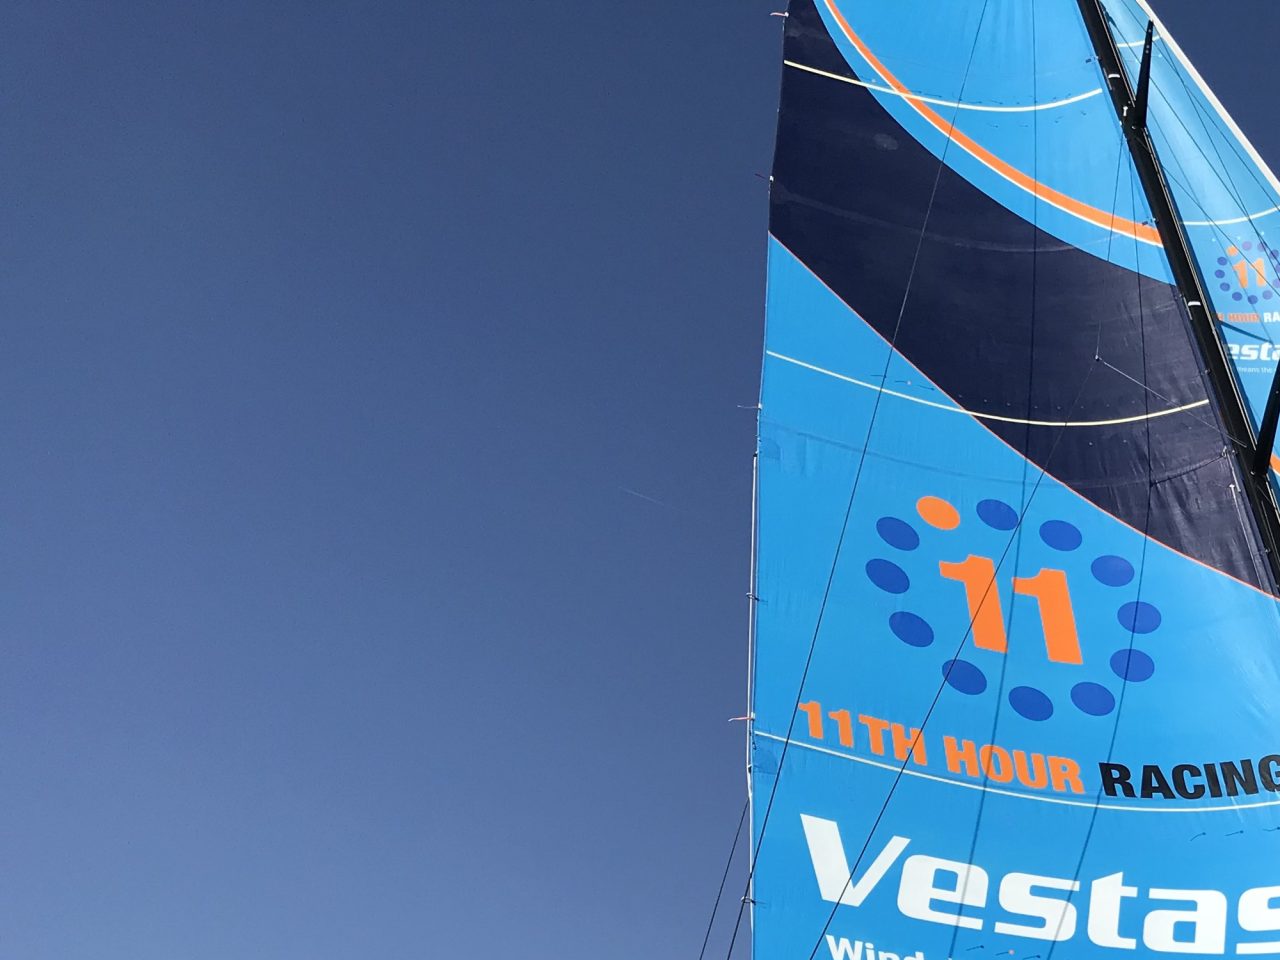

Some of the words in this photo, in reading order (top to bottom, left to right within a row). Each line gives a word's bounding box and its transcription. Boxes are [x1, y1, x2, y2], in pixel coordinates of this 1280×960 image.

[939, 554, 1084, 665] 11
[798, 700, 928, 766] 11TH
[943, 735, 1086, 794] HOUR
